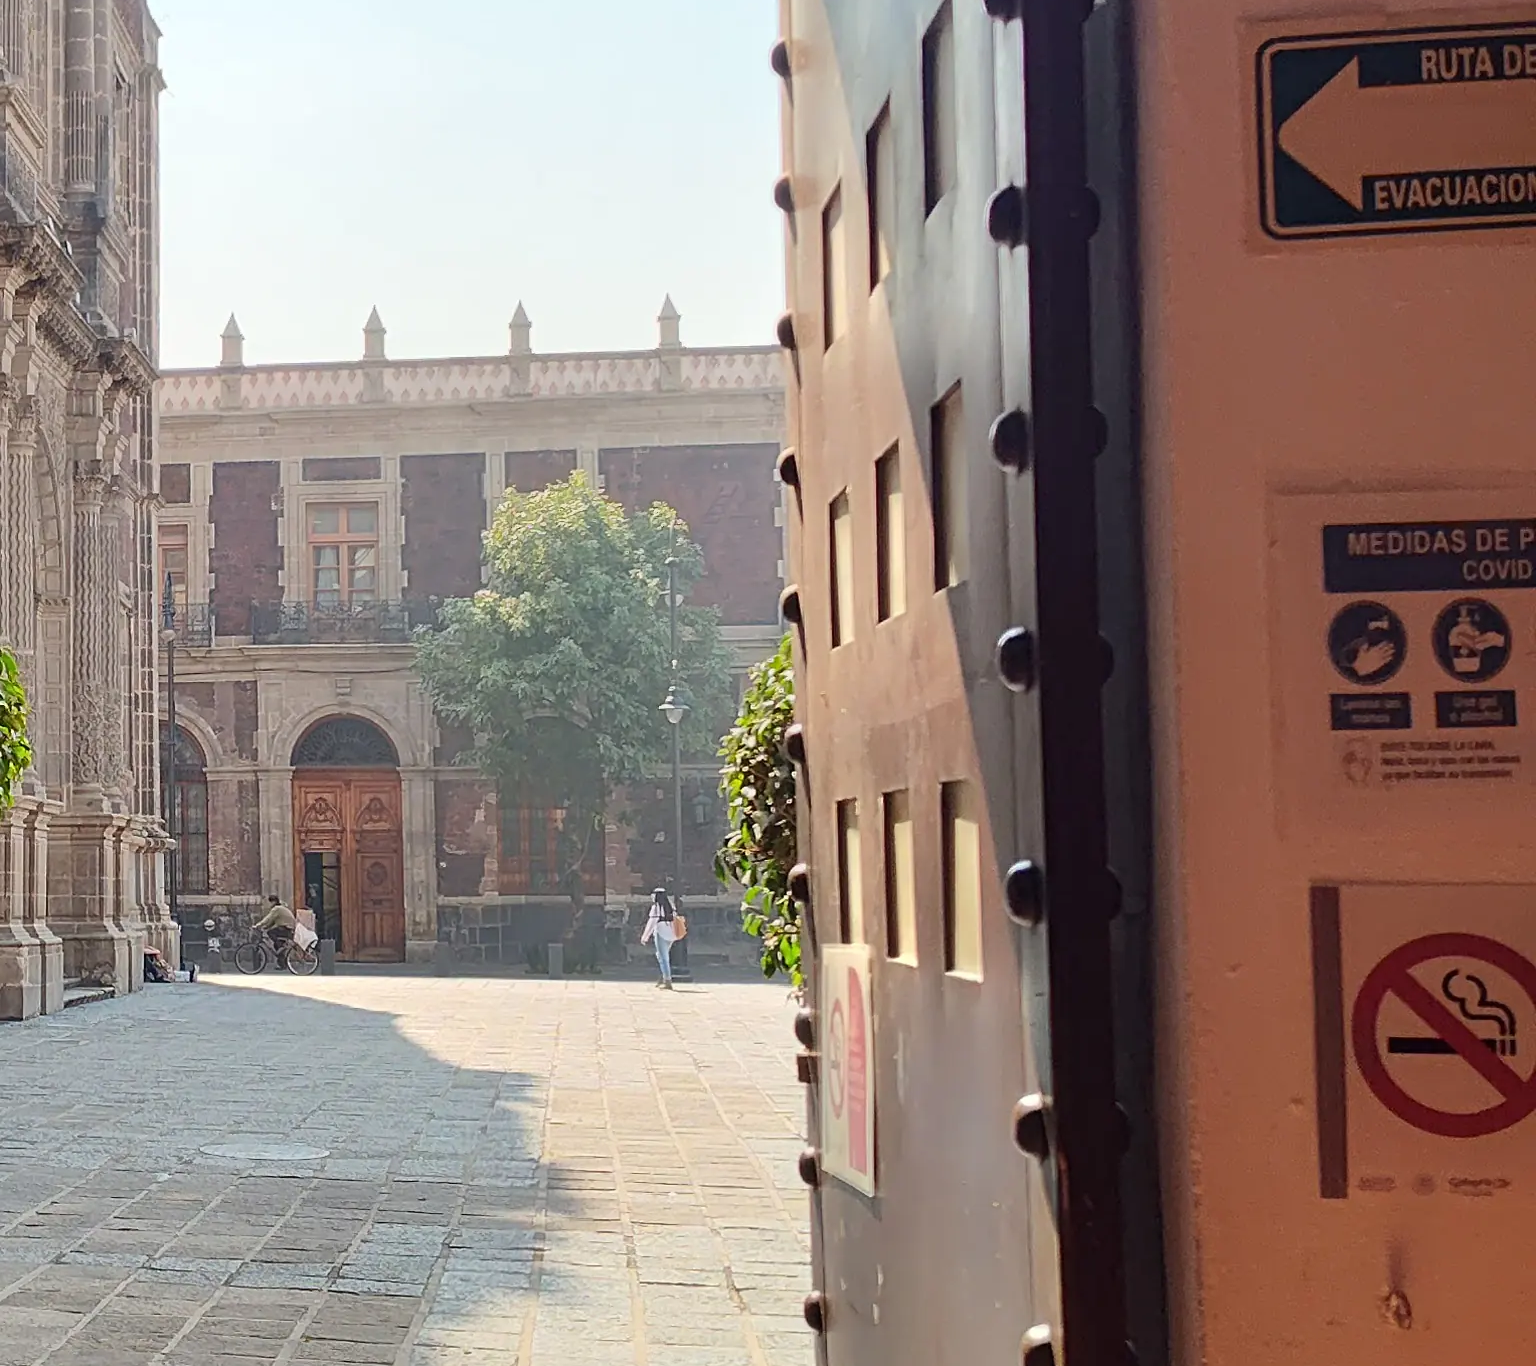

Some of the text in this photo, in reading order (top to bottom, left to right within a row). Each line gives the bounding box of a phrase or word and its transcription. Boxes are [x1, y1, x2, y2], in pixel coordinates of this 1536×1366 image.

[1421, 44, 1536, 80] RUTA DE
[1348, 529, 1466, 556] MEDIDAS
[1475, 528, 1510, 553] DE
[1463, 559, 1533, 581] COVID
